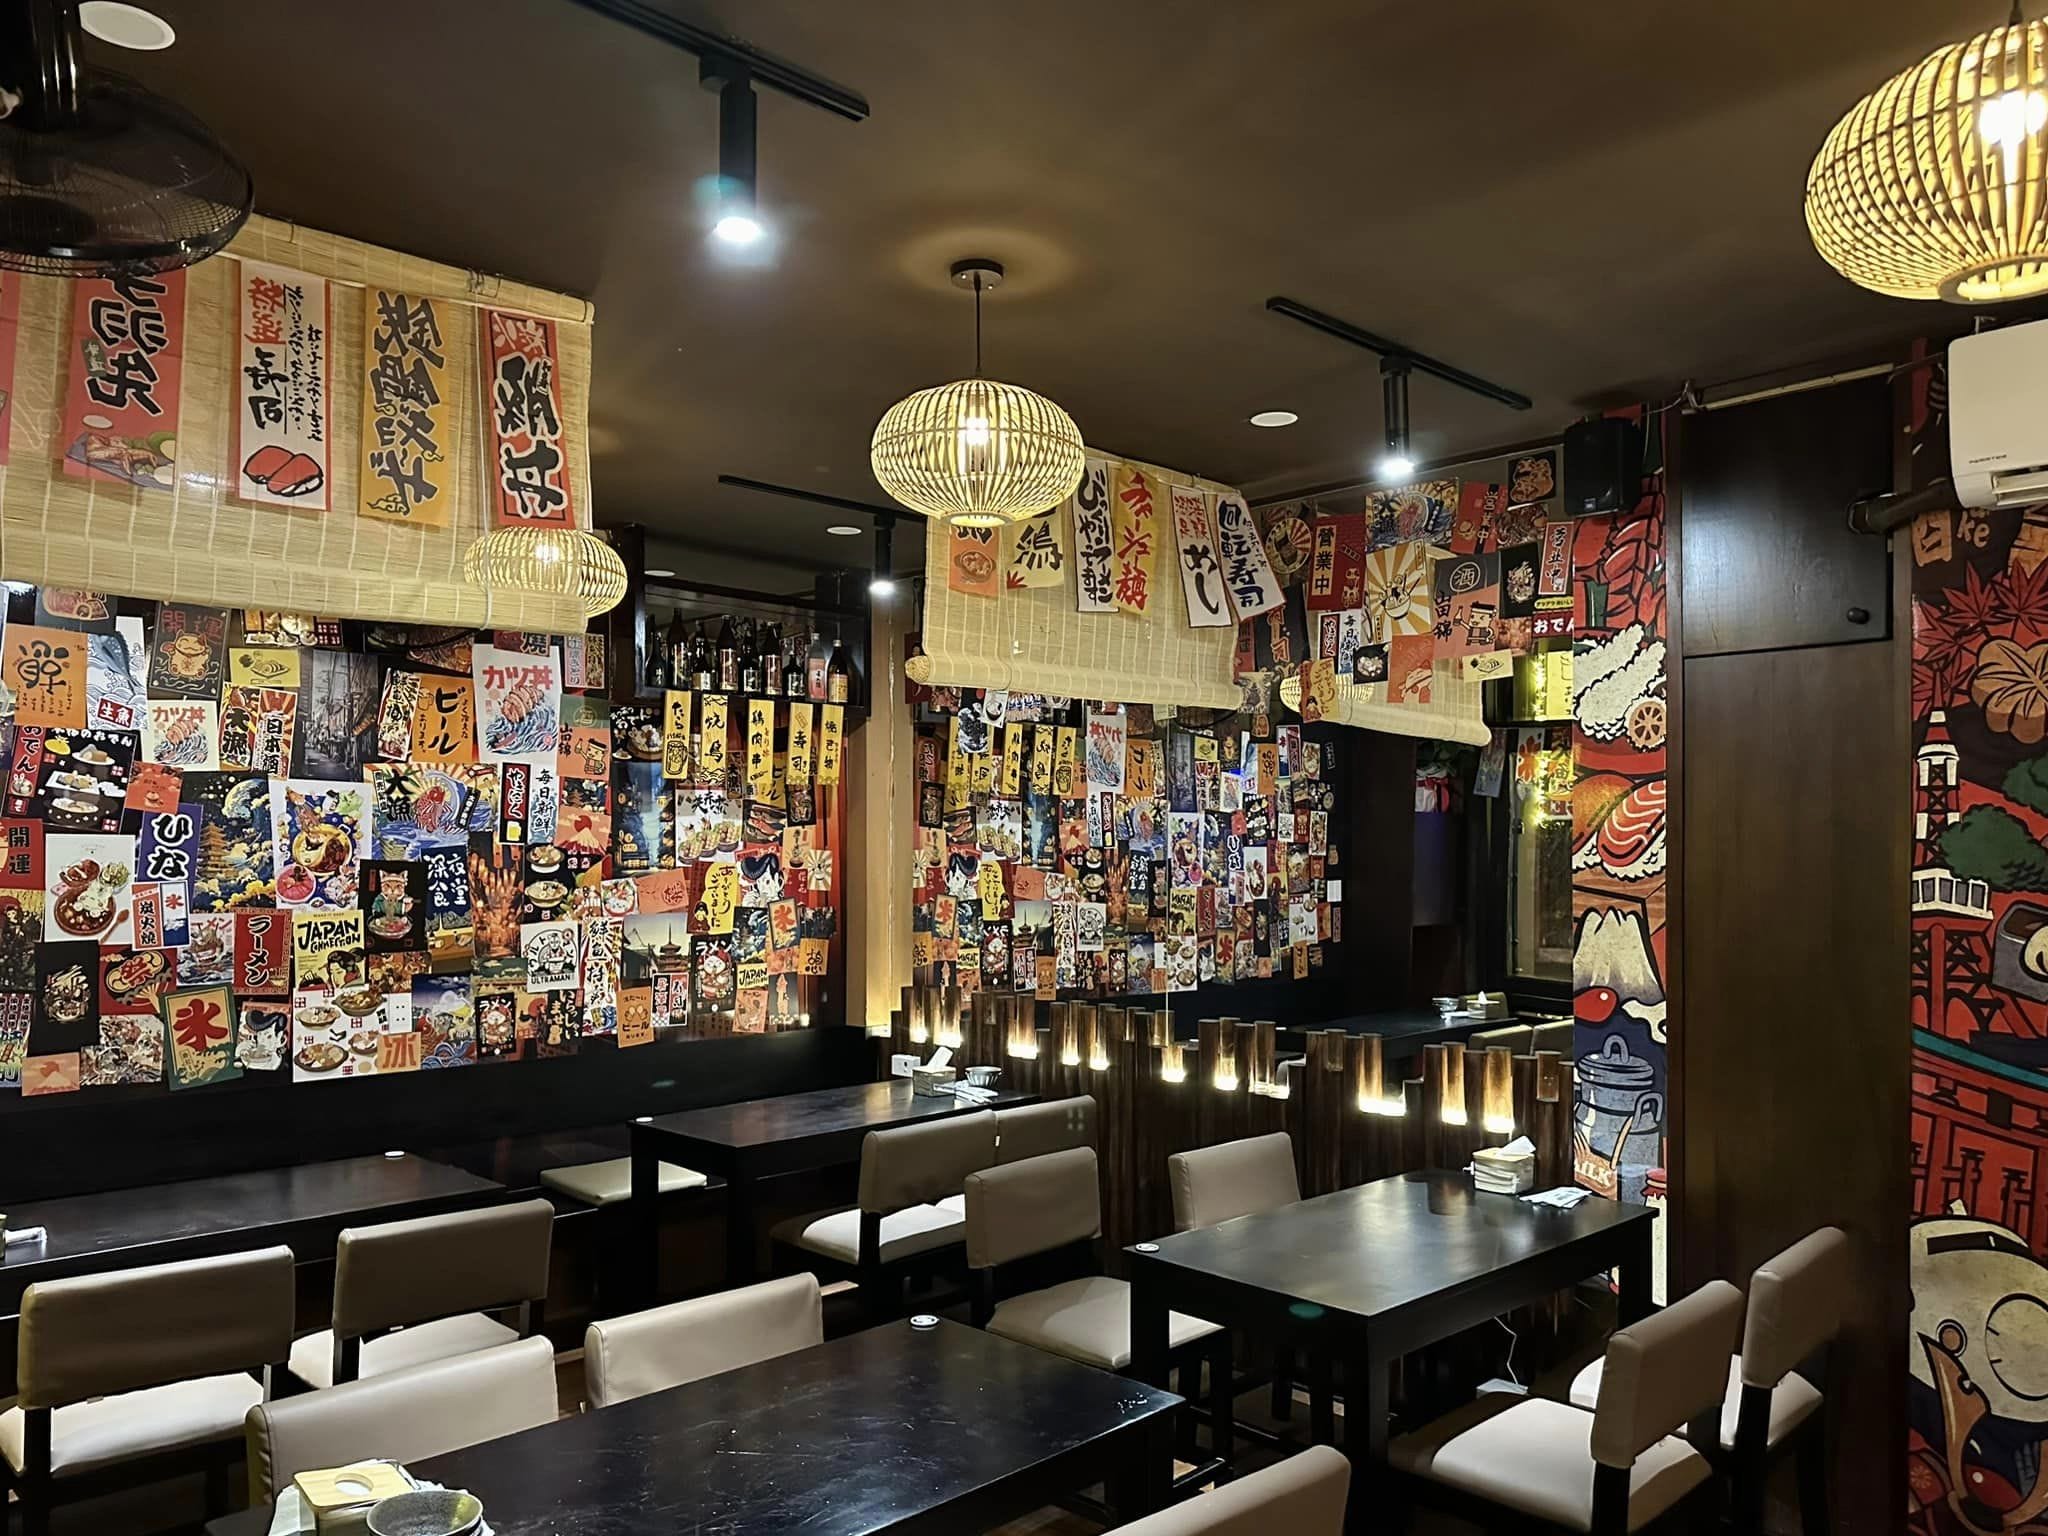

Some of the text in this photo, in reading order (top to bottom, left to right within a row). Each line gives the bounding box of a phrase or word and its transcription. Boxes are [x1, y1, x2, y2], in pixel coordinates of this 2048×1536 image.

[1218, 500, 1265, 608] 回転寿司
[1182, 544, 1218, 615] めし
[1433, 591, 1453, 642] 山田錦
[483, 665, 553, 690] カツ丼
[152, 706, 207, 723] カツ丼
[428, 686, 466, 755] ビール
[791, 731, 806, 771] 寿司
[534, 768, 554, 834] 毎日新鮮
[9, 826, 31, 875] 開運
[149, 813, 193, 879] ひな
[423, 853, 467, 880] 深夜
[428, 877, 469, 907] 食堂
[139, 900, 157, 945] 炭火焼
[297, 918, 359, 950] JAPAN
[244, 914, 272, 987] ラーメン
[696, 941, 733, 954] ラメン
[531, 974, 571, 985] ULTRAMAN
[739, 968, 768, 985] JAPAN
[172, 998, 229, 1051] 氷
[479, 999, 511, 1011] ラメン
